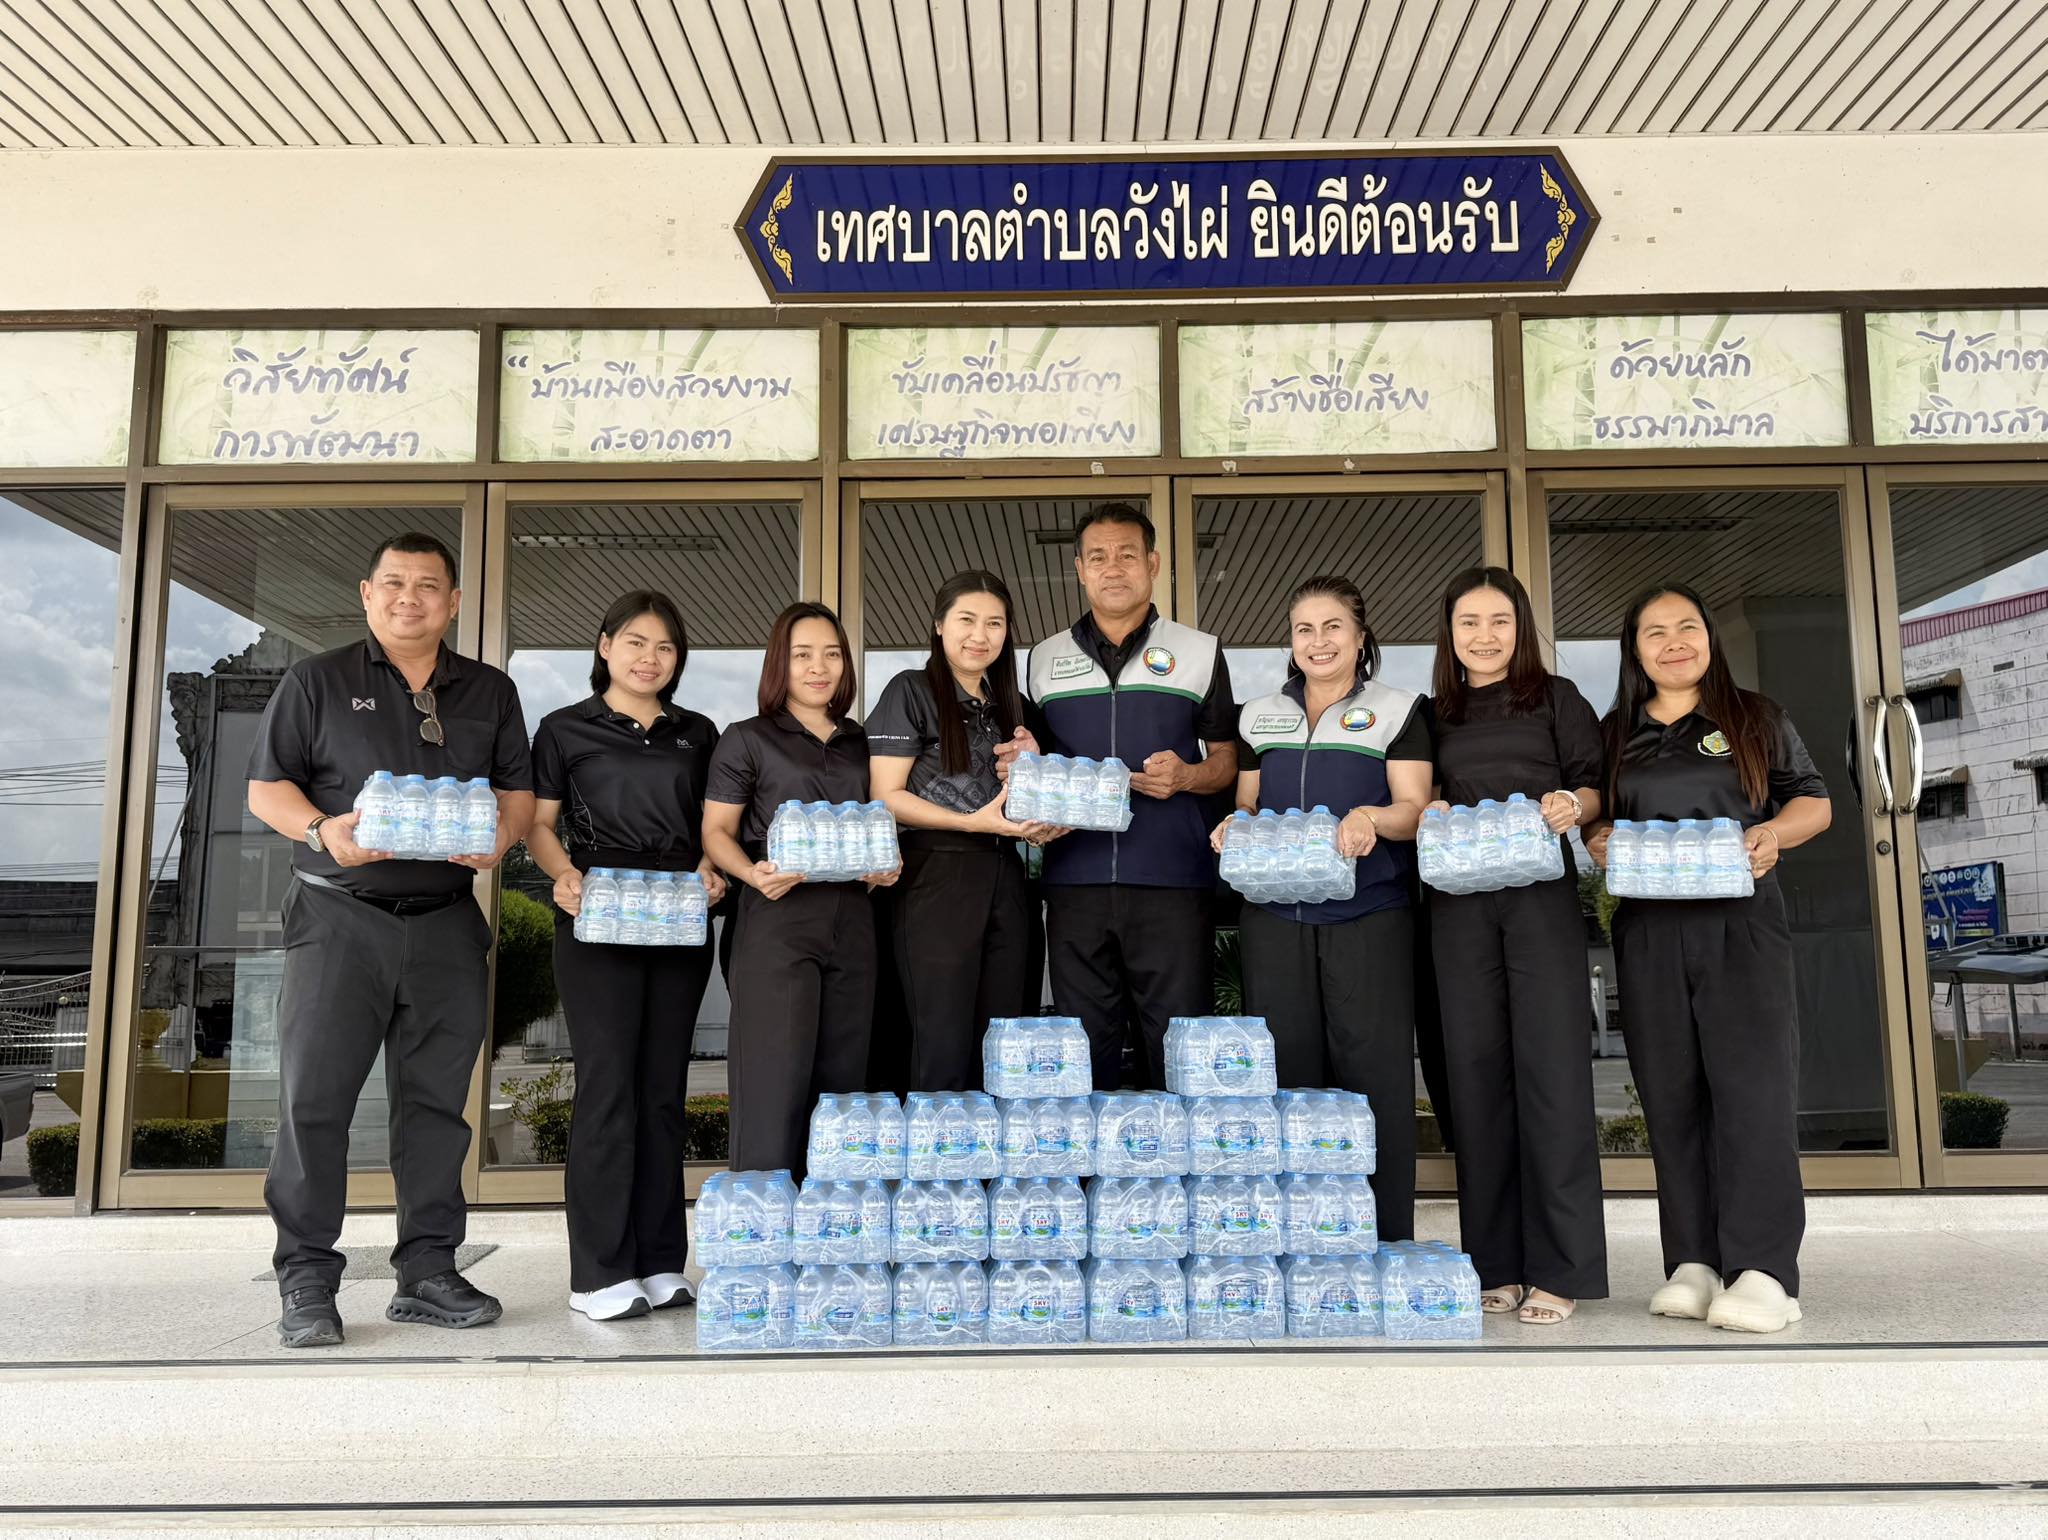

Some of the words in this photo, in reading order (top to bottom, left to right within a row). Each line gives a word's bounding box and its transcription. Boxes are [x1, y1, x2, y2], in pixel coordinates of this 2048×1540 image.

[816, 181, 1229, 263] เทศบาลตำบลวังไผ่
[1246, 174, 1520, 258] ยินดีต้อนรับ
[223, 346, 419, 396] วิสัยทัศน์
[1609, 337, 1751, 379] ด้วยหลัก
[1243, 358, 1430, 415] สร้างชื่อเสียง
[213, 408, 420, 458] การพัฒนา
[590, 425, 732, 452] สะอาดตา
[877, 406, 1136, 458] เศรษฐกิจพอเพียง
[1592, 396, 1775, 440] ธรรมาภิบาล
